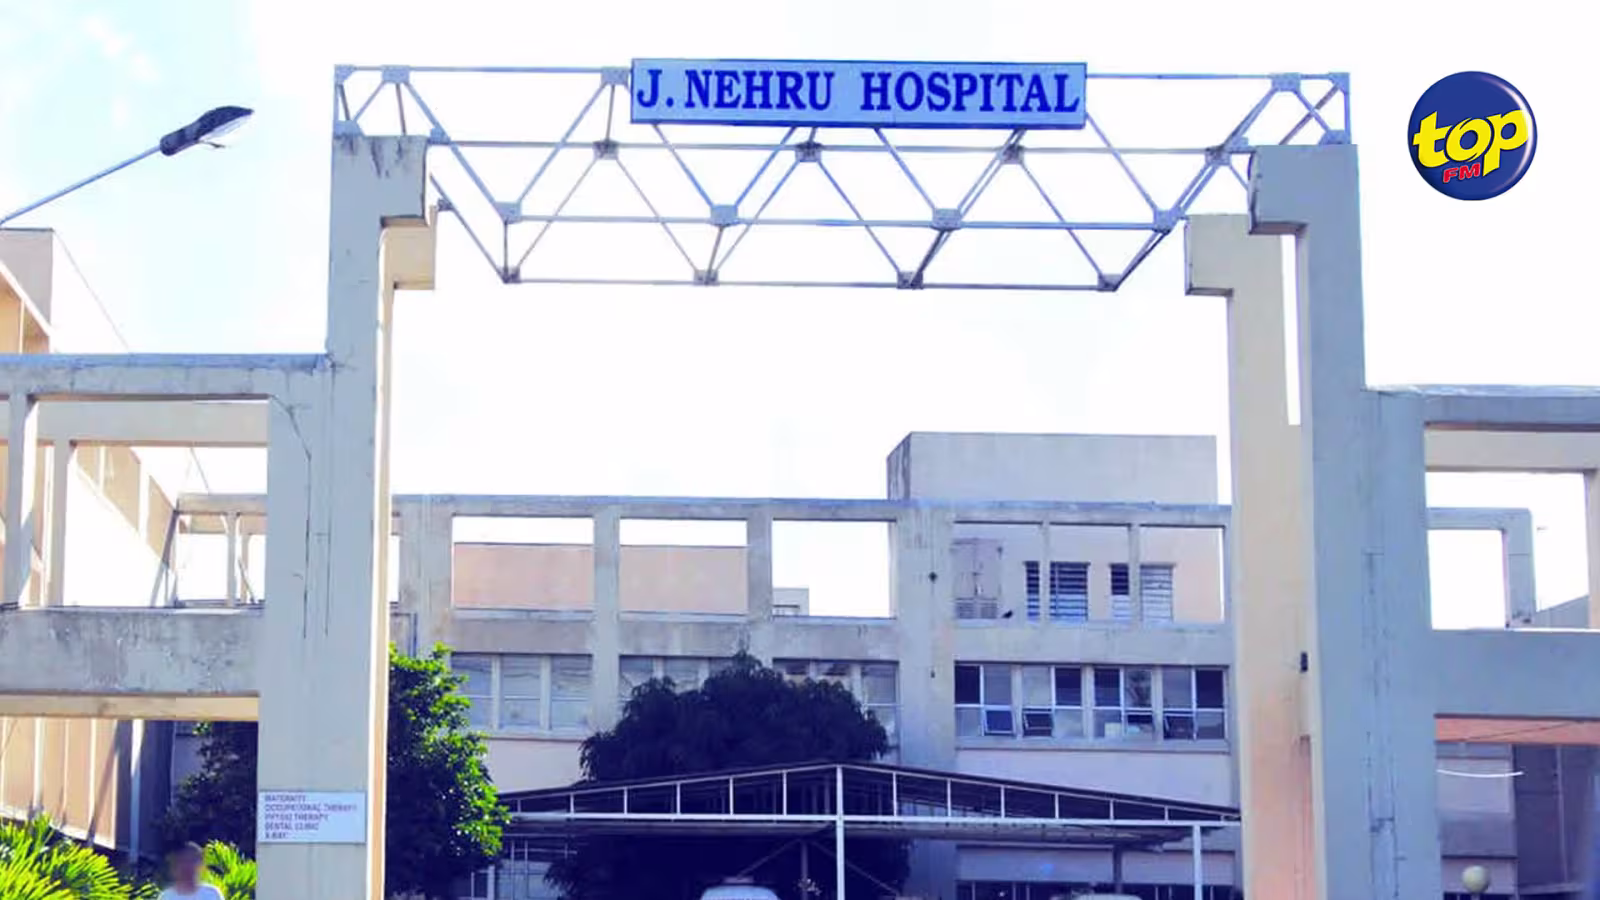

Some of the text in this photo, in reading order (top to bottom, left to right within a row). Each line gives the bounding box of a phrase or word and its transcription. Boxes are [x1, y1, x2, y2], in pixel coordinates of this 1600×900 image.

[637, 69, 1080, 113] J. NEHRU HOSPITAL
